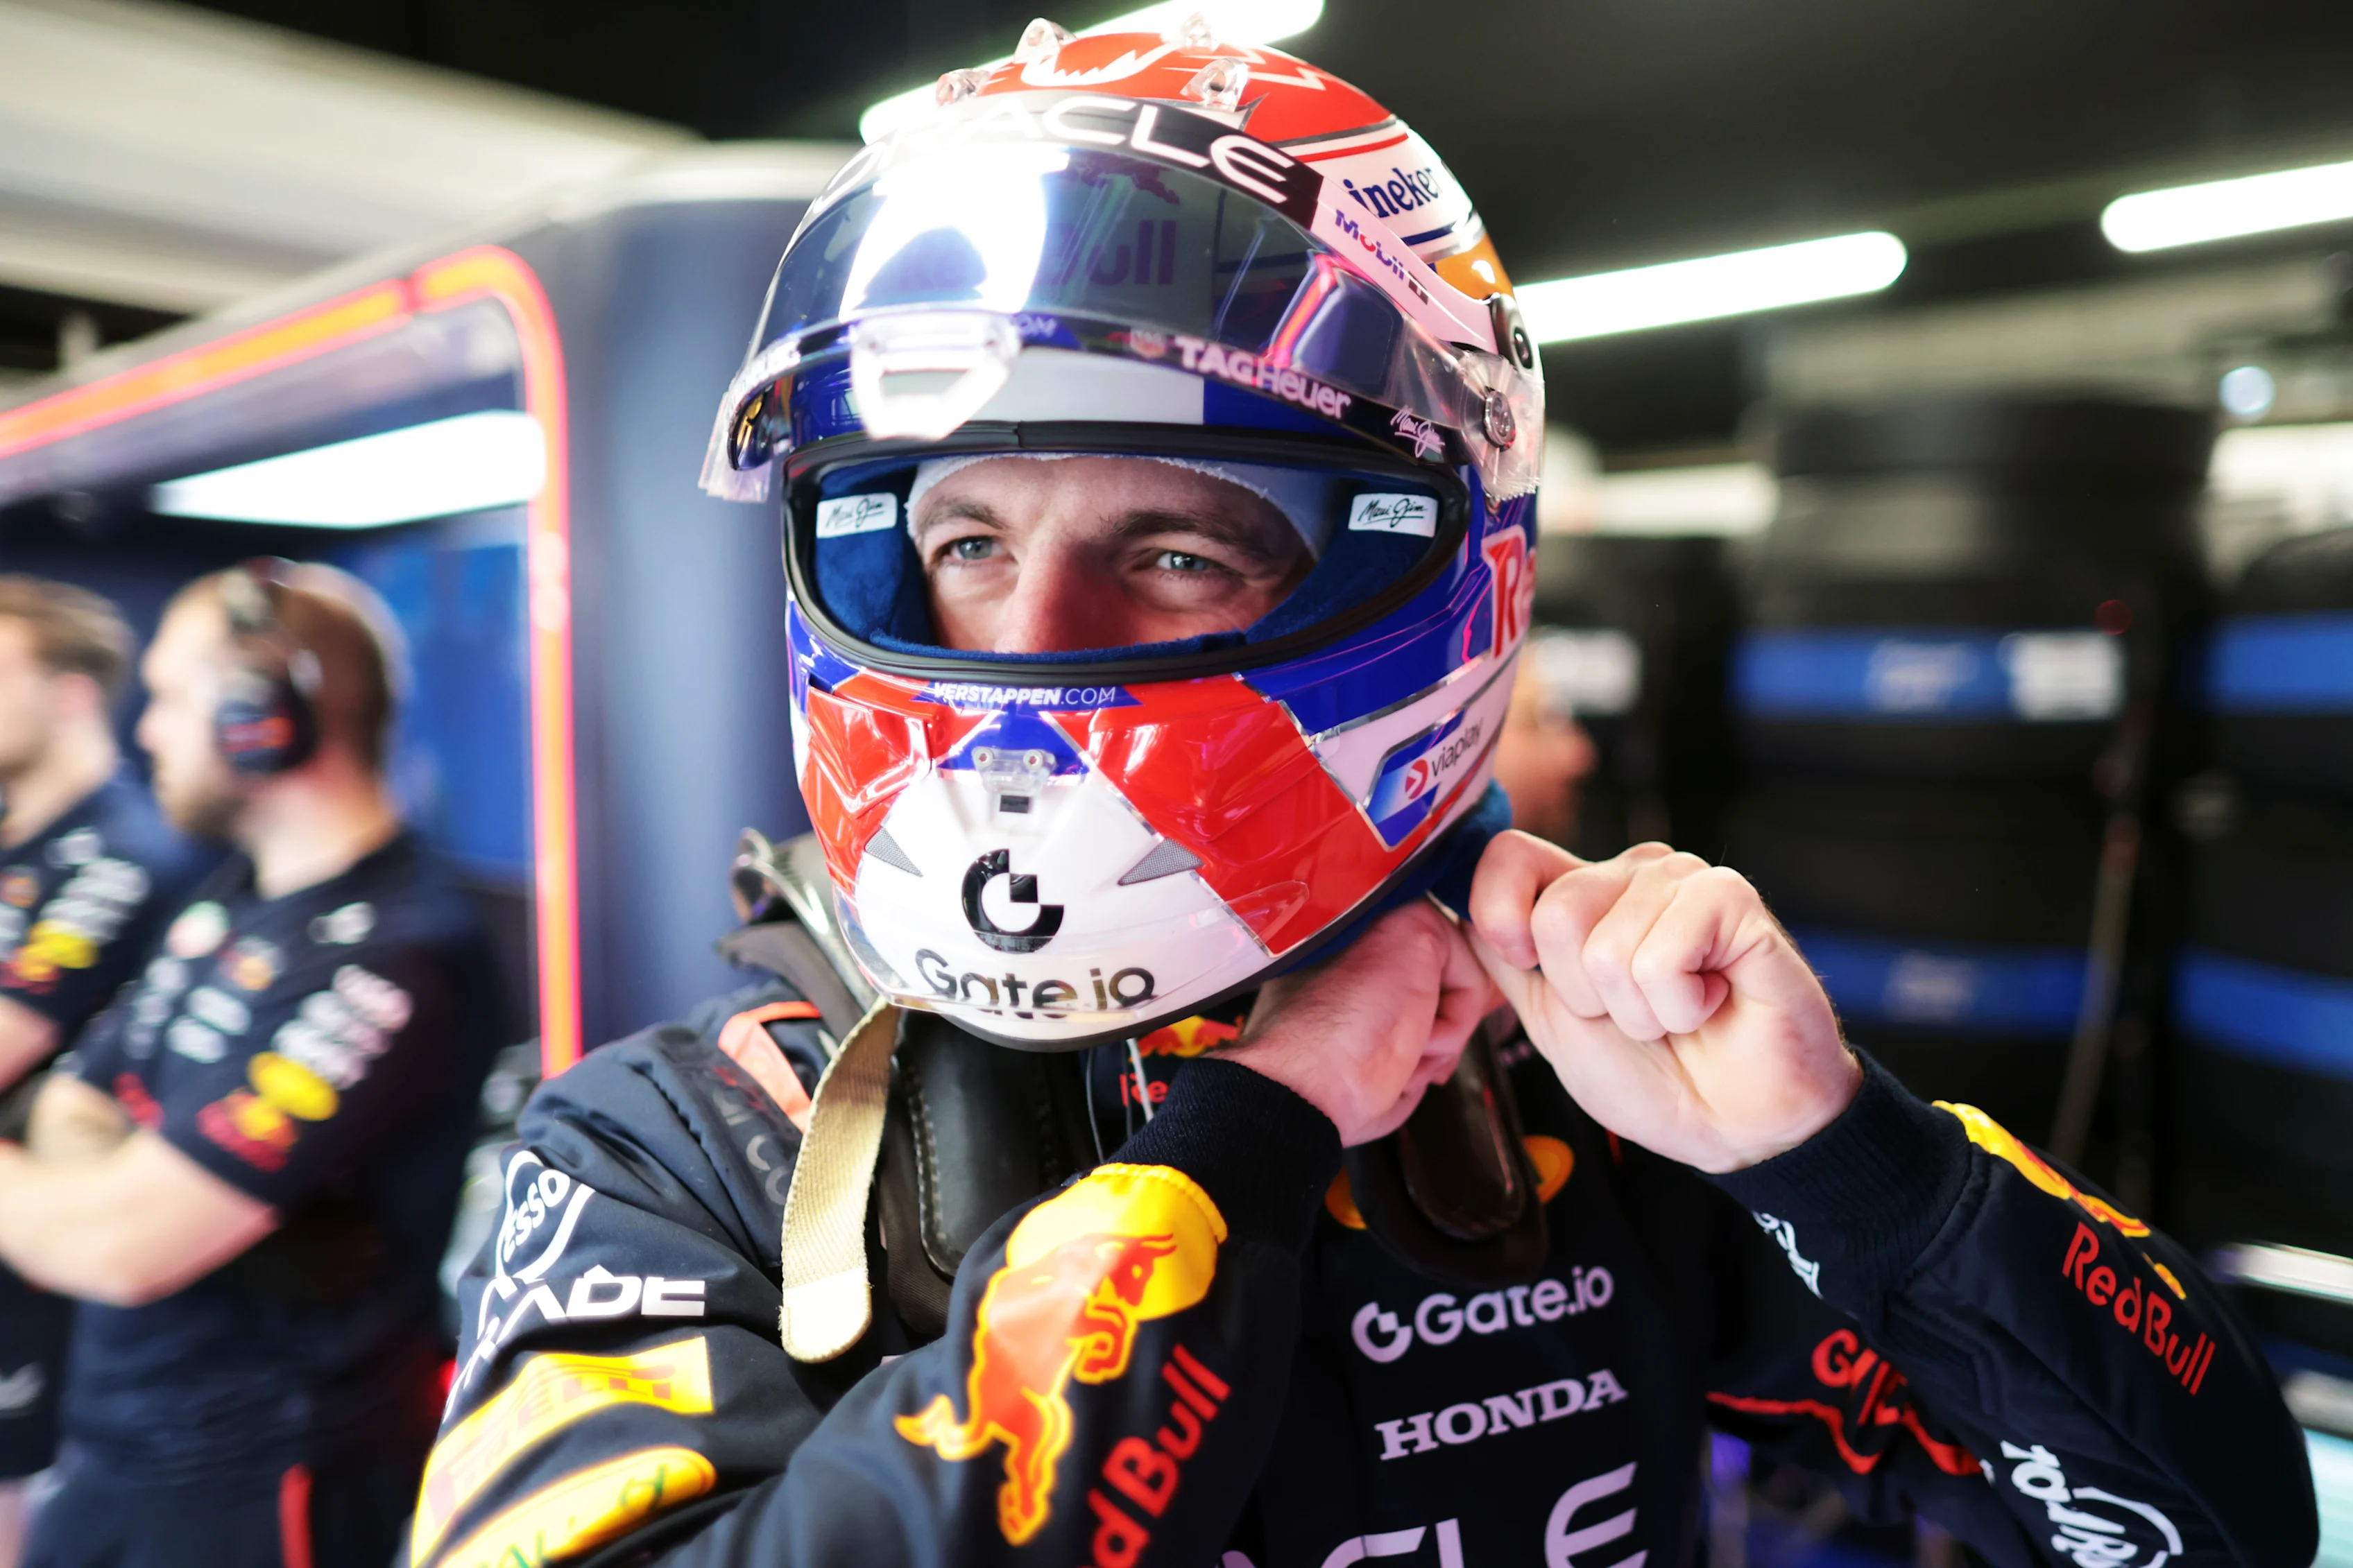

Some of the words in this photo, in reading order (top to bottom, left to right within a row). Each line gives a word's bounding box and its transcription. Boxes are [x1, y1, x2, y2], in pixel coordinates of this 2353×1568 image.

[812, 96, 1295, 214] OACLE
[1335, 209, 1405, 281] Mobil
[1175, 334, 1253, 385] TAG
[1256, 362, 1352, 419] Heuer
[1358, 499, 1392, 522] Maui
[933, 682, 1116, 705] VERSTAPPEN.COM
[915, 948, 1161, 1020] Gateio
[1414, 1266, 1614, 1345] Gate.io
[1374, 1368, 1629, 1461] HONDA
